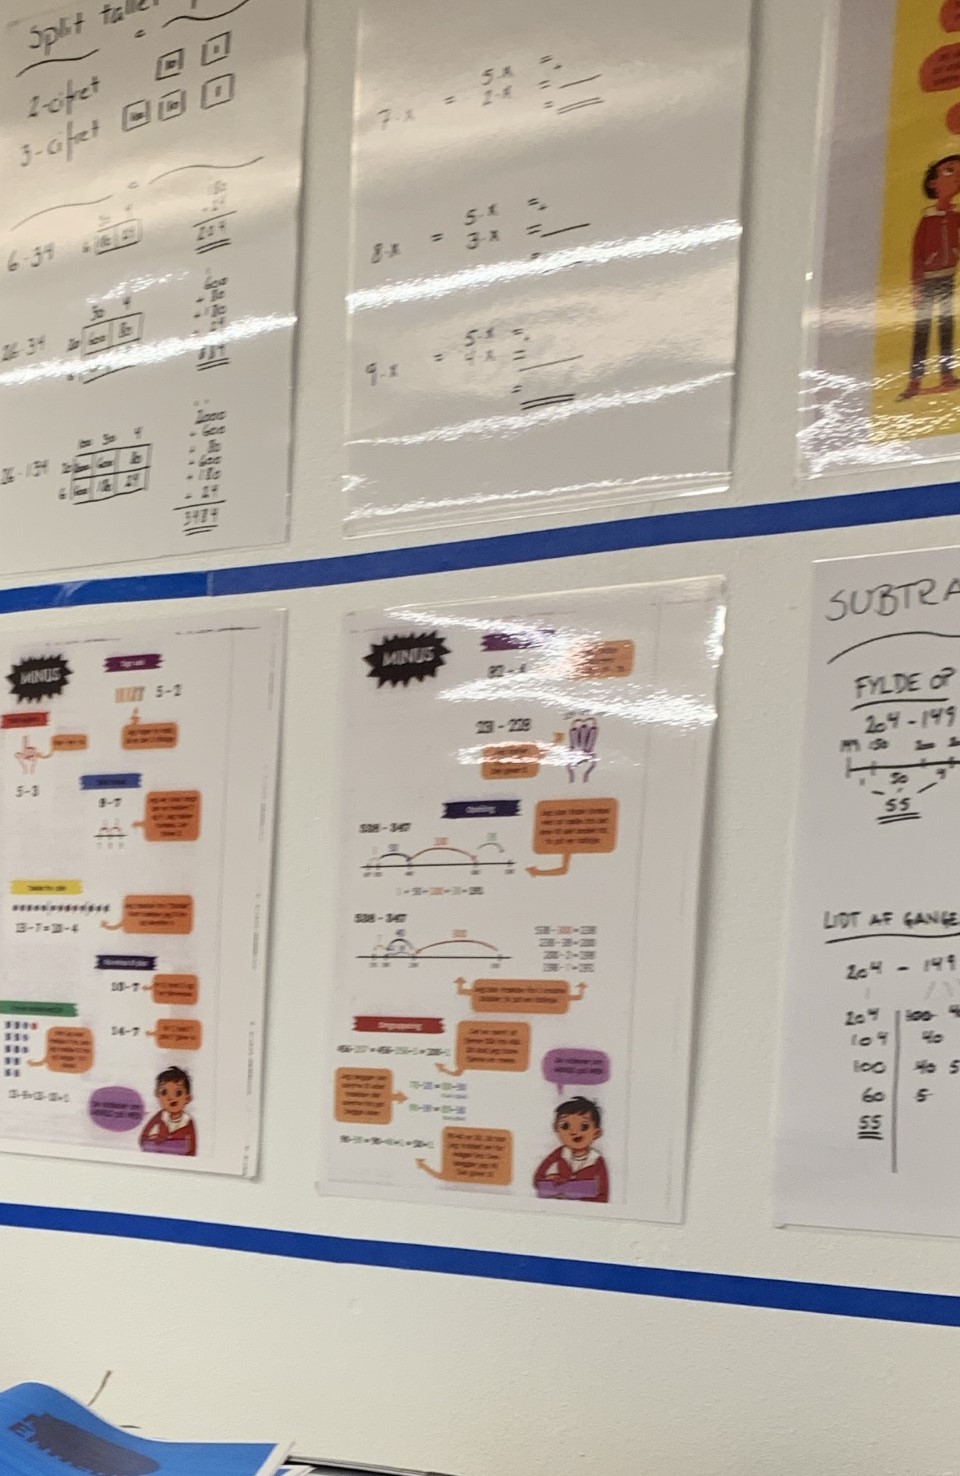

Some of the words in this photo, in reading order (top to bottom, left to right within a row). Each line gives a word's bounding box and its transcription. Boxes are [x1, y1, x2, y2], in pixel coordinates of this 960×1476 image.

[27, 12, 83, 56] Split
[382, 647, 436, 666] MINUS
[19, 667, 62, 686] MINUS
[854, 671, 922, 699] FYLDE
